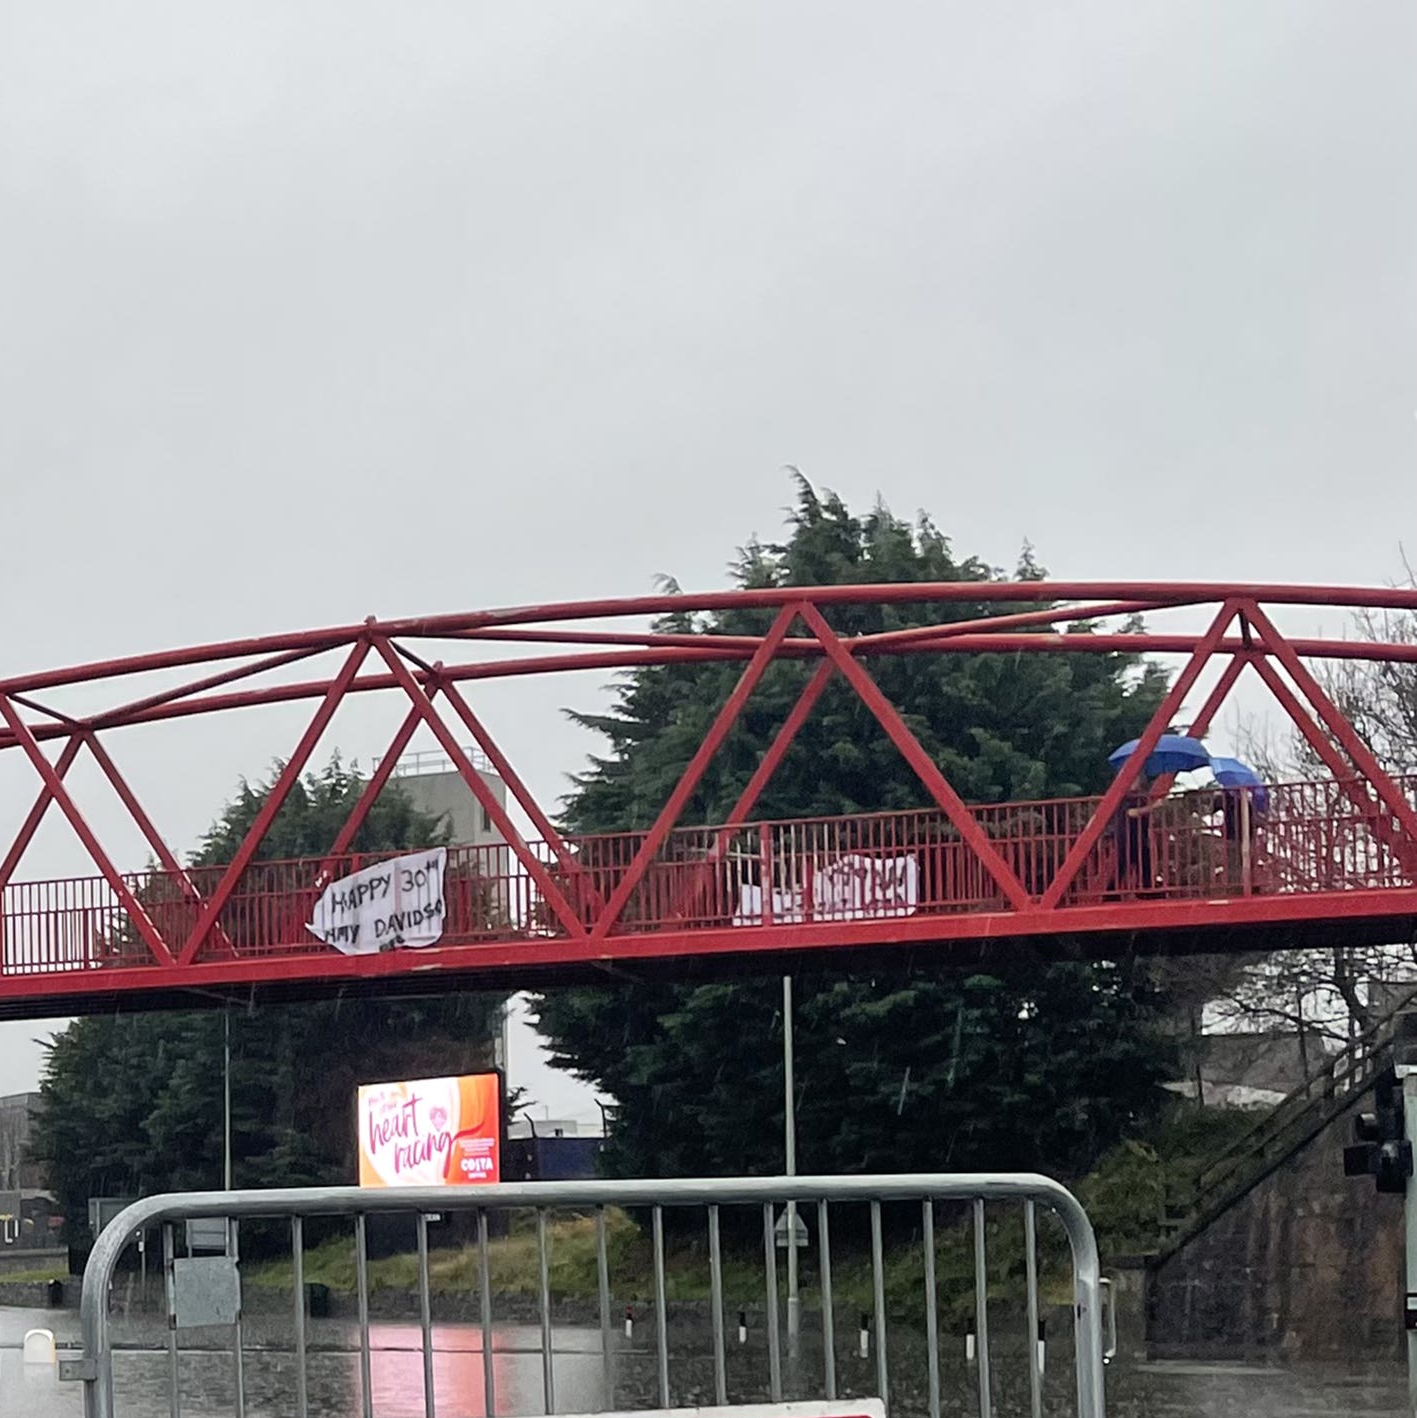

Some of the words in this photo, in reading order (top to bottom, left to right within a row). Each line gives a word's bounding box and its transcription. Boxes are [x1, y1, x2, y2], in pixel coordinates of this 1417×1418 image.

[331, 873, 391, 914] HAPPY
[369, 1093, 423, 1155] heart
[394, 1130, 454, 1178] racing
